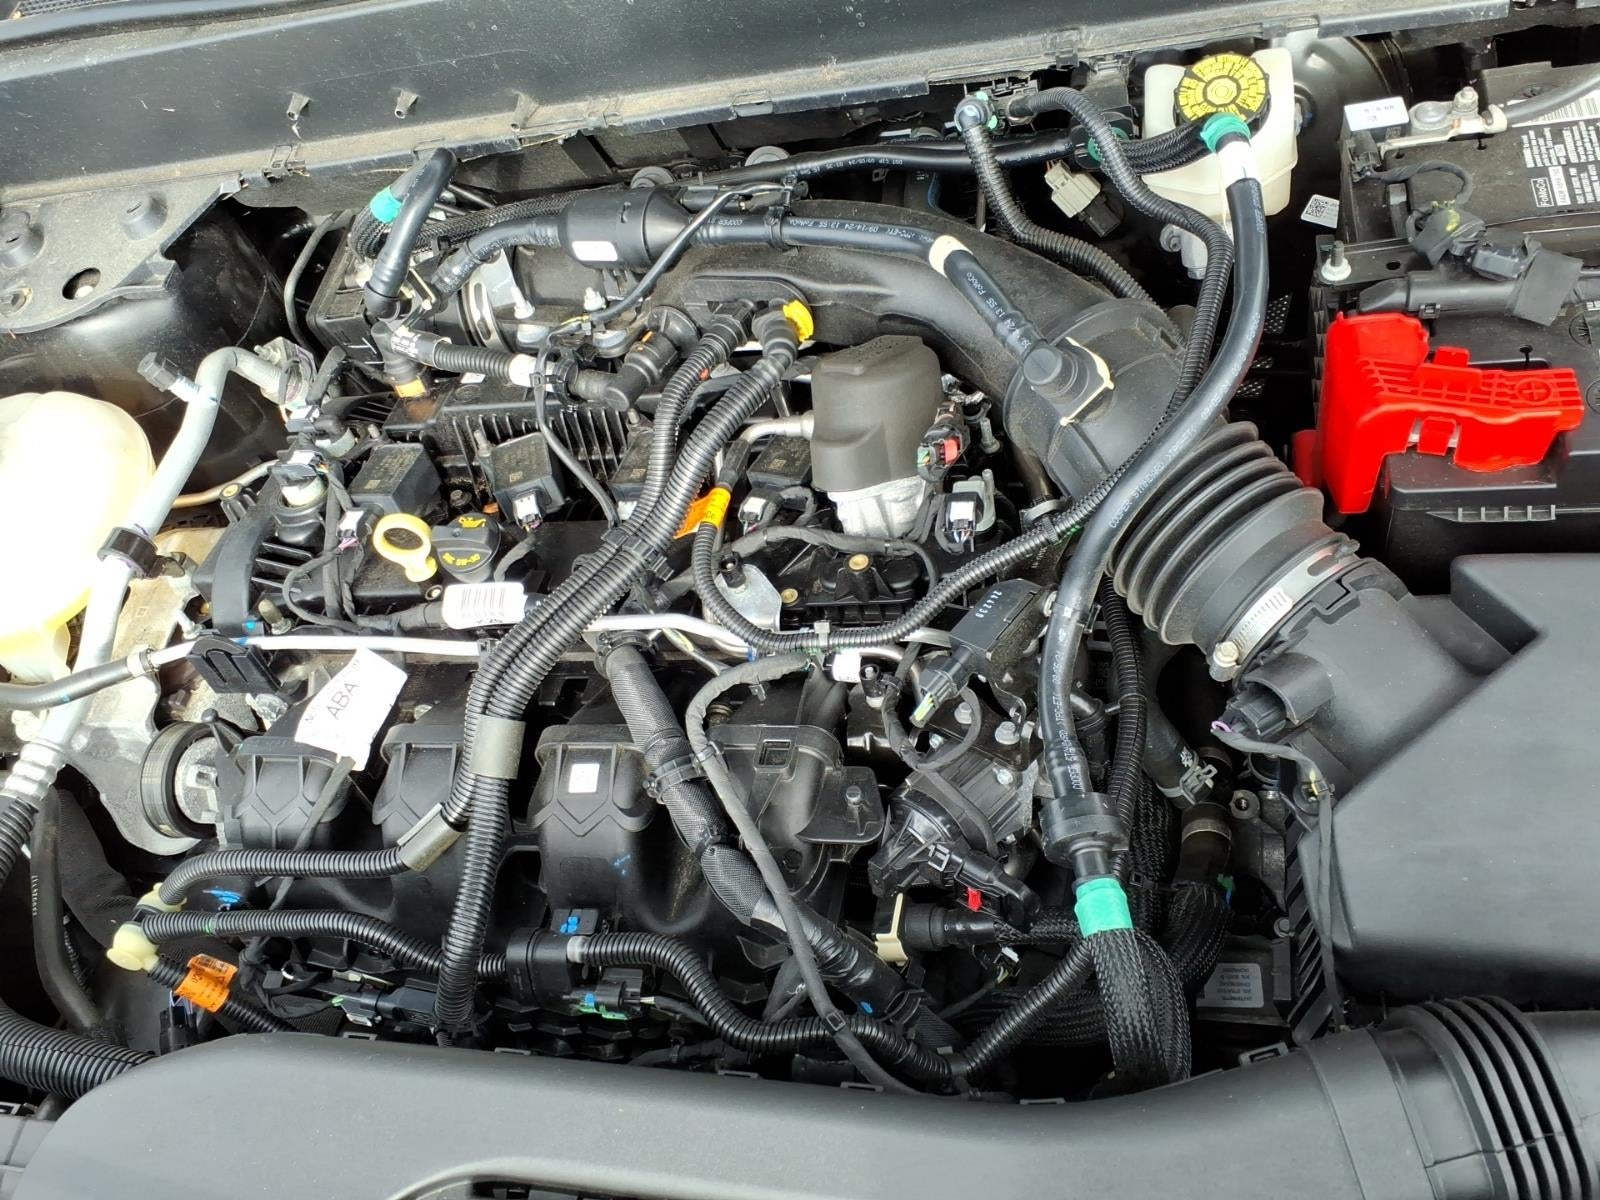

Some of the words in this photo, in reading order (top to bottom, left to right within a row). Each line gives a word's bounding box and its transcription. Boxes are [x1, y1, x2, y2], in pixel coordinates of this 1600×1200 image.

[1535, 178, 1550, 206] FoMoCo
[964, 270, 987, 296] FoMoCo
[985, 296, 1006, 319] 13:55
[324, 680, 359, 720] ABA
